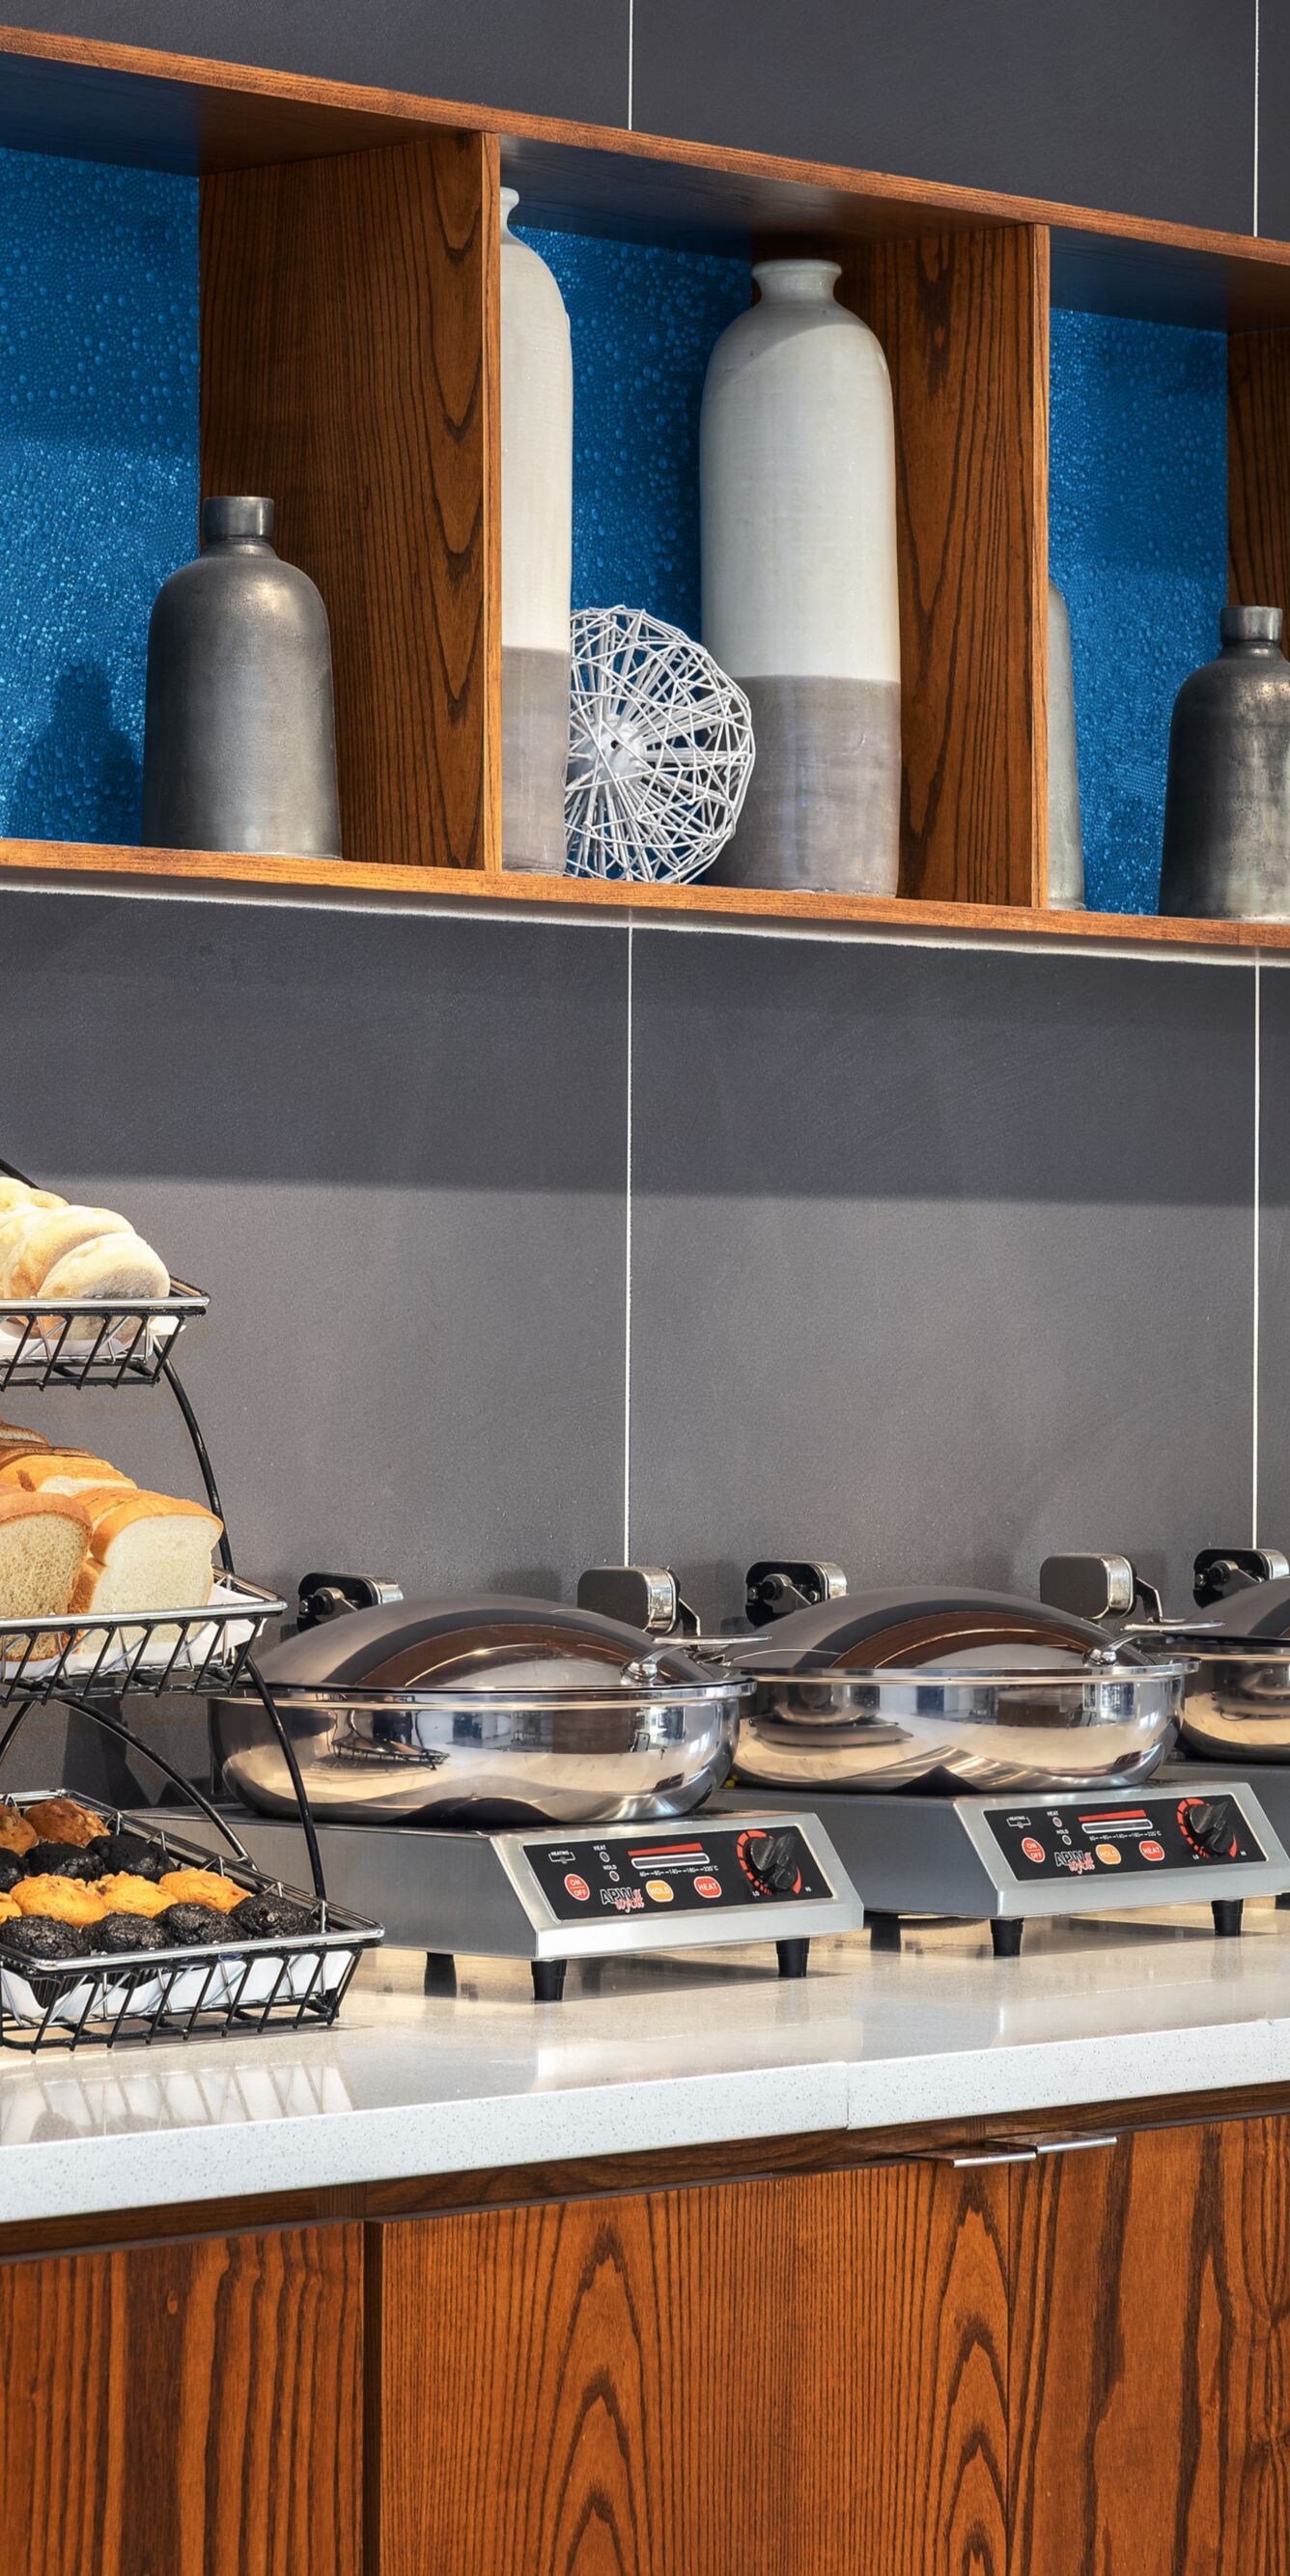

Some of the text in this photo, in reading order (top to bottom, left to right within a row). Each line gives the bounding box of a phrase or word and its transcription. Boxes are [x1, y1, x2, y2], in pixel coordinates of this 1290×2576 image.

[1054, 1850, 1084, 1867] APW
[650, 1885, 670, 1894] HOLD
[698, 1882, 717, 1891] HEAT
[600, 1887, 632, 1905] APW
